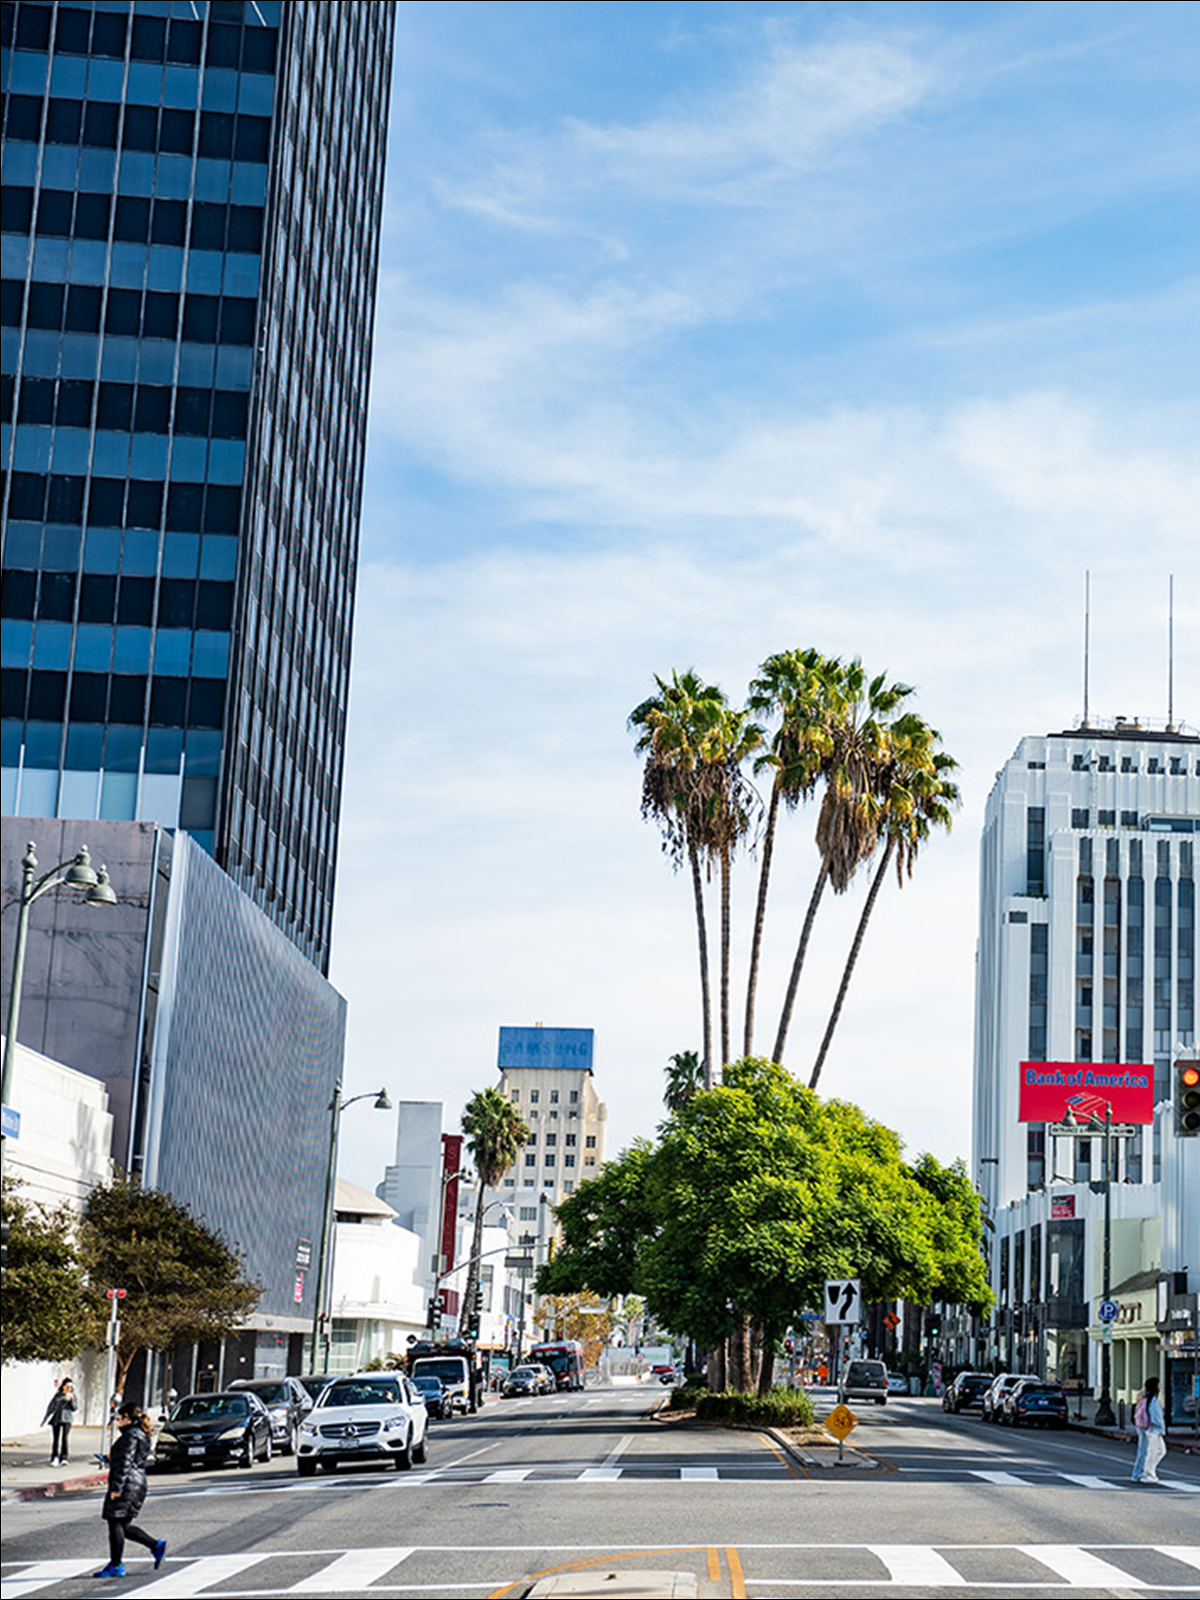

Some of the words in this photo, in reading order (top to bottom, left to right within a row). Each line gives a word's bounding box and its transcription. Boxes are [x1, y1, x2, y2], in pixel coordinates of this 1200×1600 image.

[504, 1041, 588, 1056] SAMSUNG
[1026, 1069, 1065, 1086] Bank
[1066, 1071, 1083, 1086] of
[1083, 1071, 1149, 1088] America
